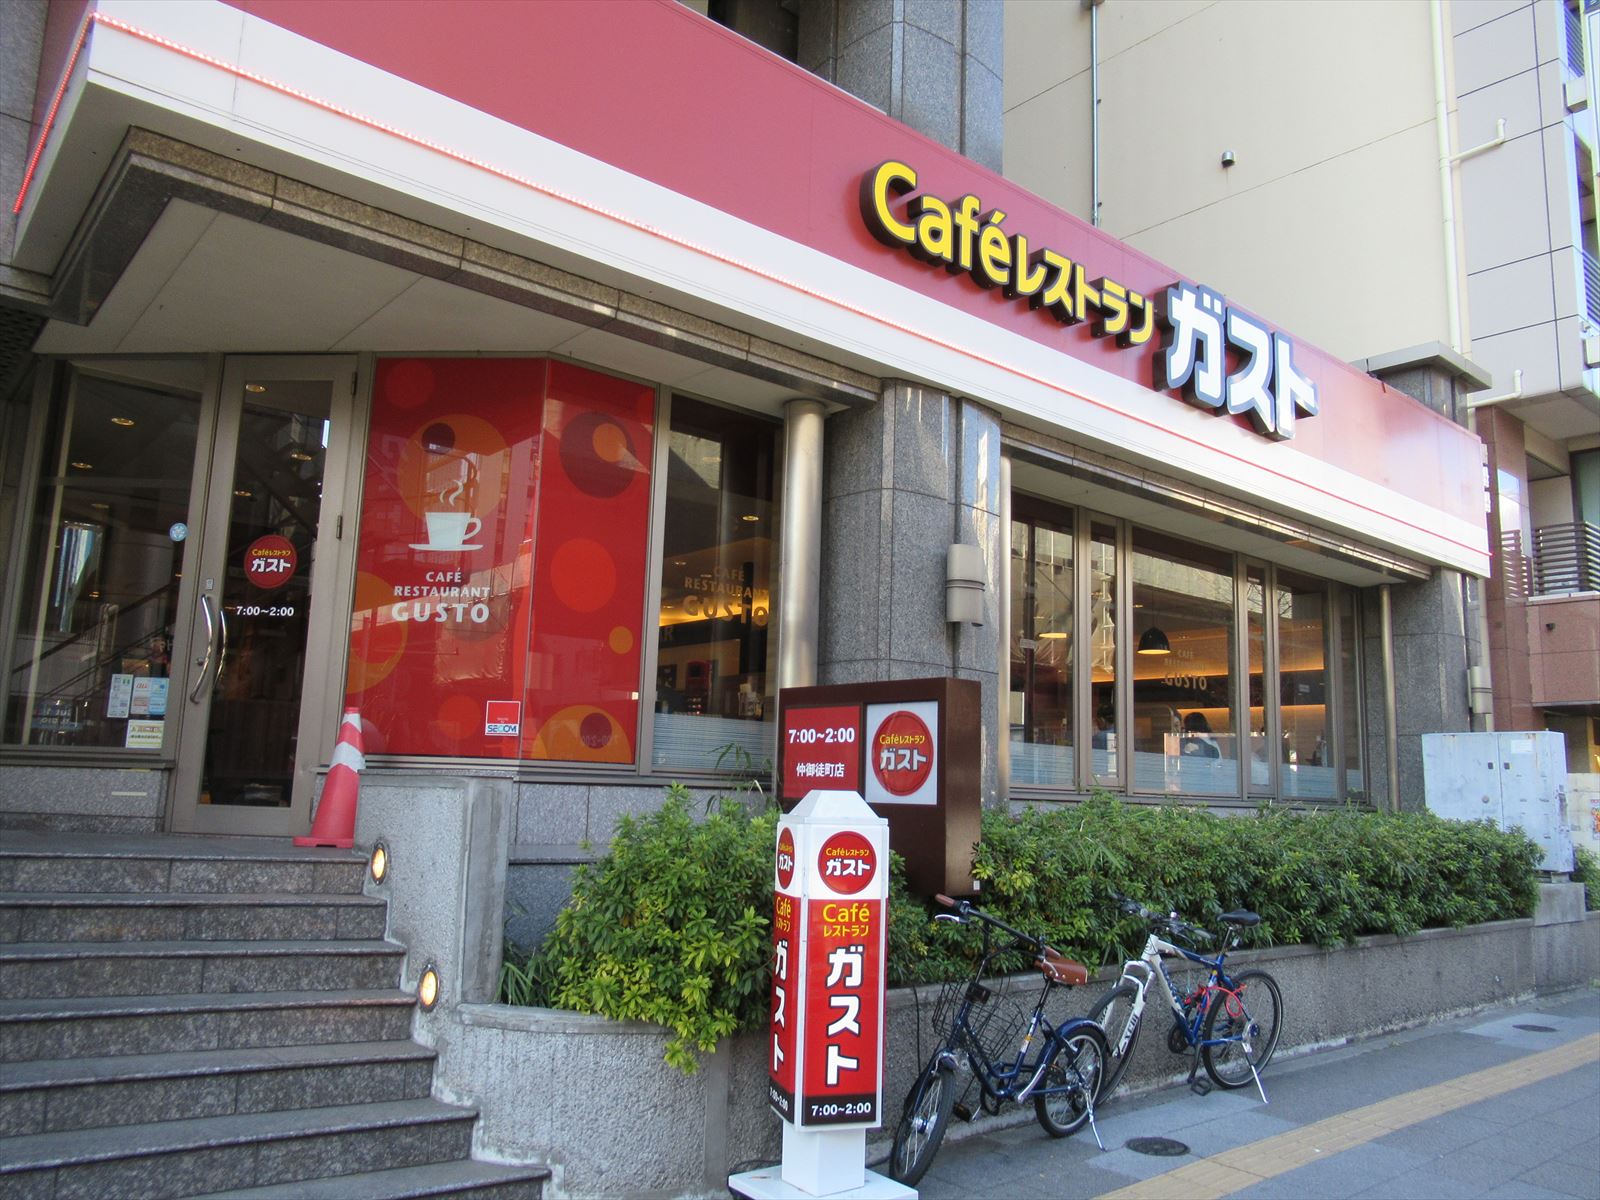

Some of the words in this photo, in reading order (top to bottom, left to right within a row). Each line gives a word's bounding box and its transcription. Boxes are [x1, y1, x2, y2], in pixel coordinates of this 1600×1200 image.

[1167, 284, 1319, 439] ガスト
[251, 557, 291, 573] ガスト
[426, 567, 462, 582] CAFÉ
[394, 586, 490, 597] RESTAURANT
[392, 602, 490, 623] GUSTO
[682, 595, 769, 626] GUSTO
[1164, 673, 1207, 691] GUSTO
[487, 724, 517, 733] SECOM
[879, 748, 928, 771] ガスト
[796, 762, 845, 778] 仲御徒町店
[778, 853, 793, 871] ガスト
[825, 858, 871, 876] ガスト
[776, 896, 791, 918] Café
[822, 902, 870, 923] Café
[823, 925, 869, 937] レストラン
[774, 941, 788, 1072] ガスト
[825, 945, 864, 1085] ガスト
